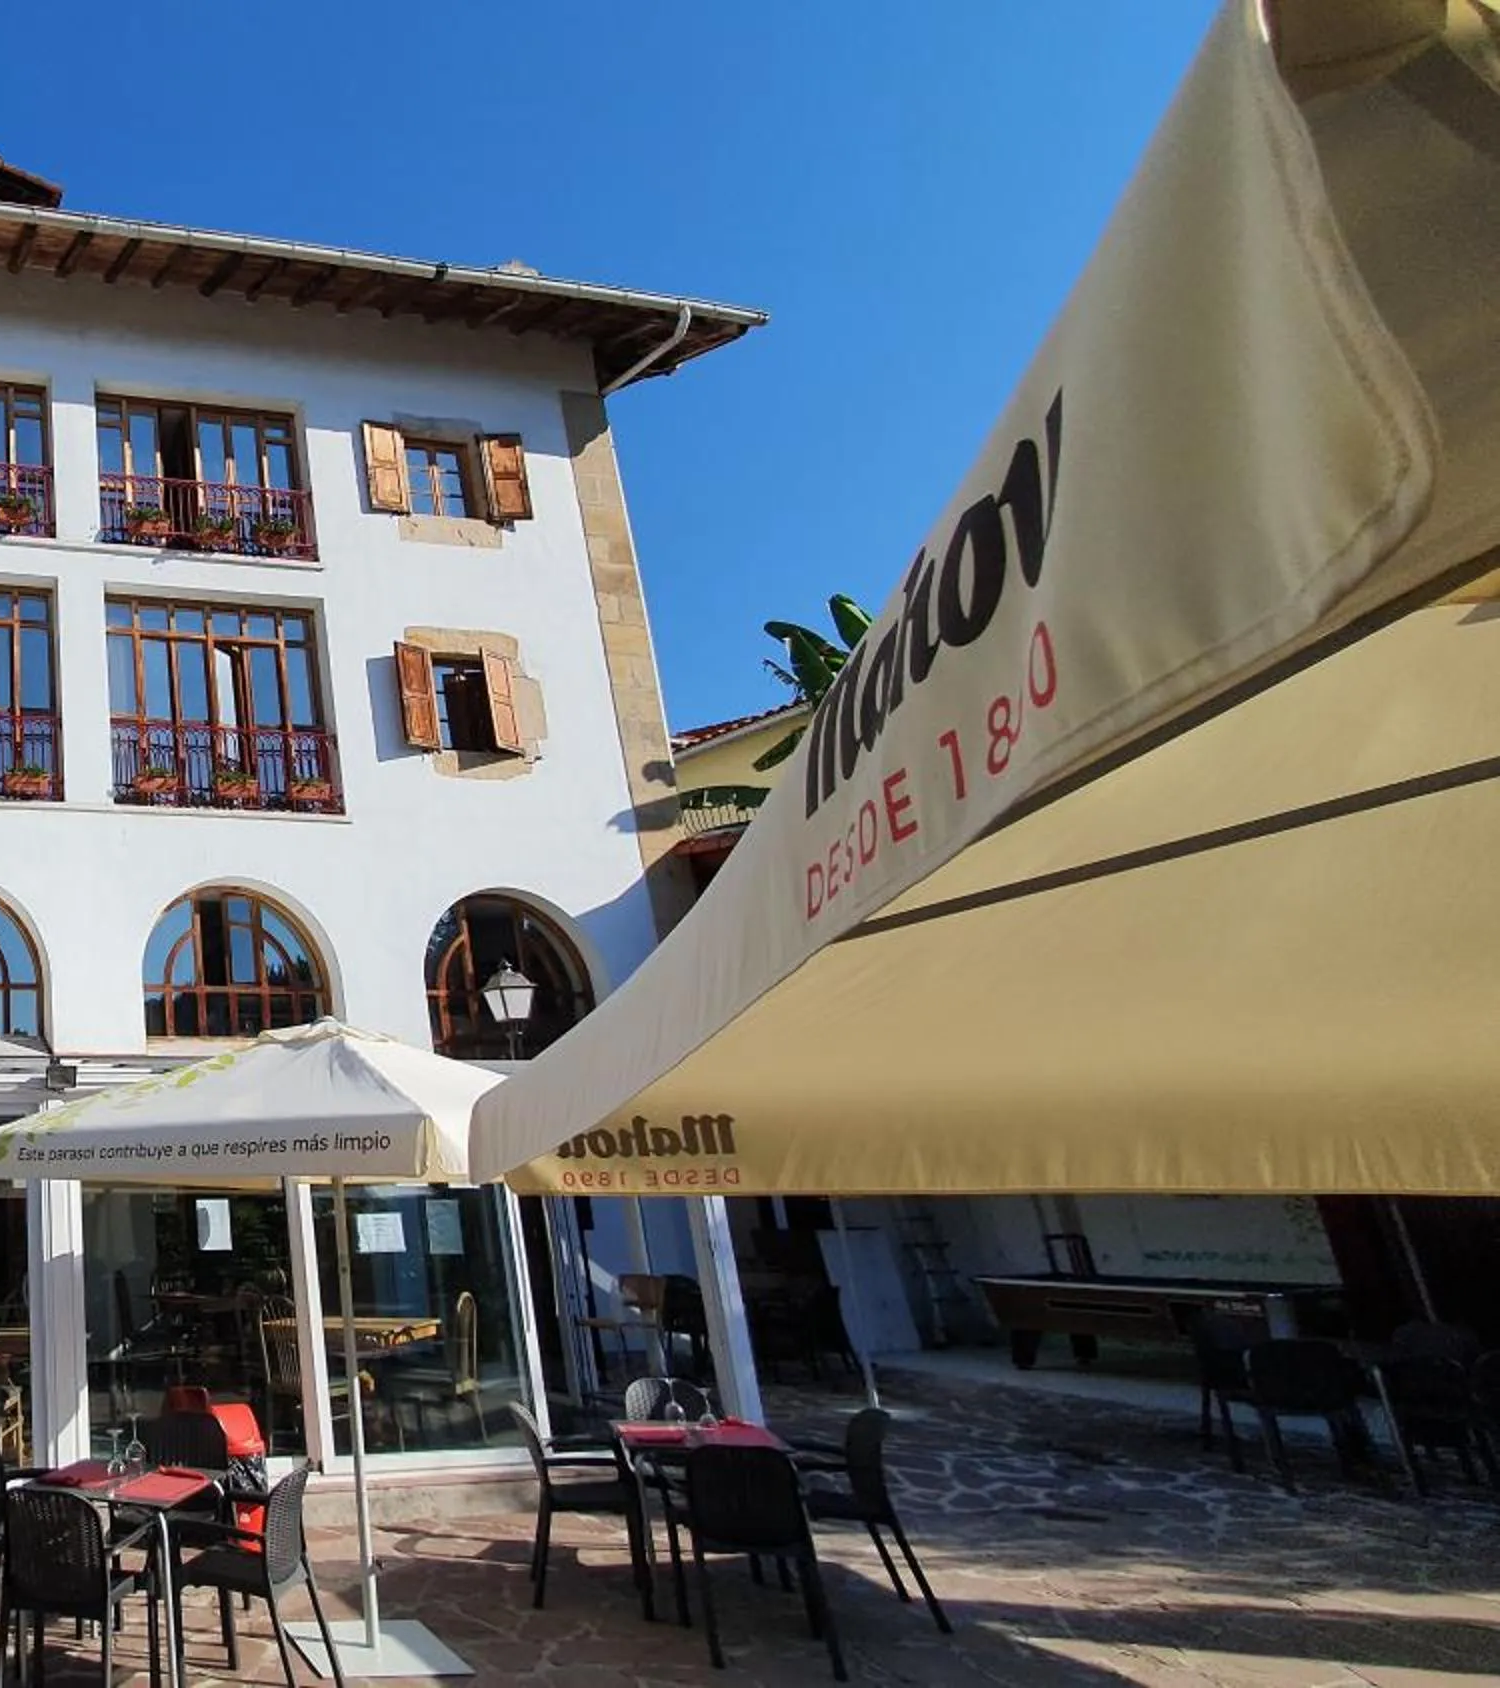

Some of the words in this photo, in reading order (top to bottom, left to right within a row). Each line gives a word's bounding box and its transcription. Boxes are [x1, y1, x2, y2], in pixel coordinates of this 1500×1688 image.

[805, 385, 1063, 820] Mahou
[806, 768, 920, 921] DESDE
[17, 1147, 45, 1161] Este
[49, 1147, 94, 1162] parasol
[99, 1143, 173, 1160] contribuye
[177, 1143, 187, 1157] a
[190, 1142, 219, 1158] que
[223, 1136, 288, 1159] respires
[293, 1133, 329, 1152] más
[334, 1130, 392, 1155] limpio
